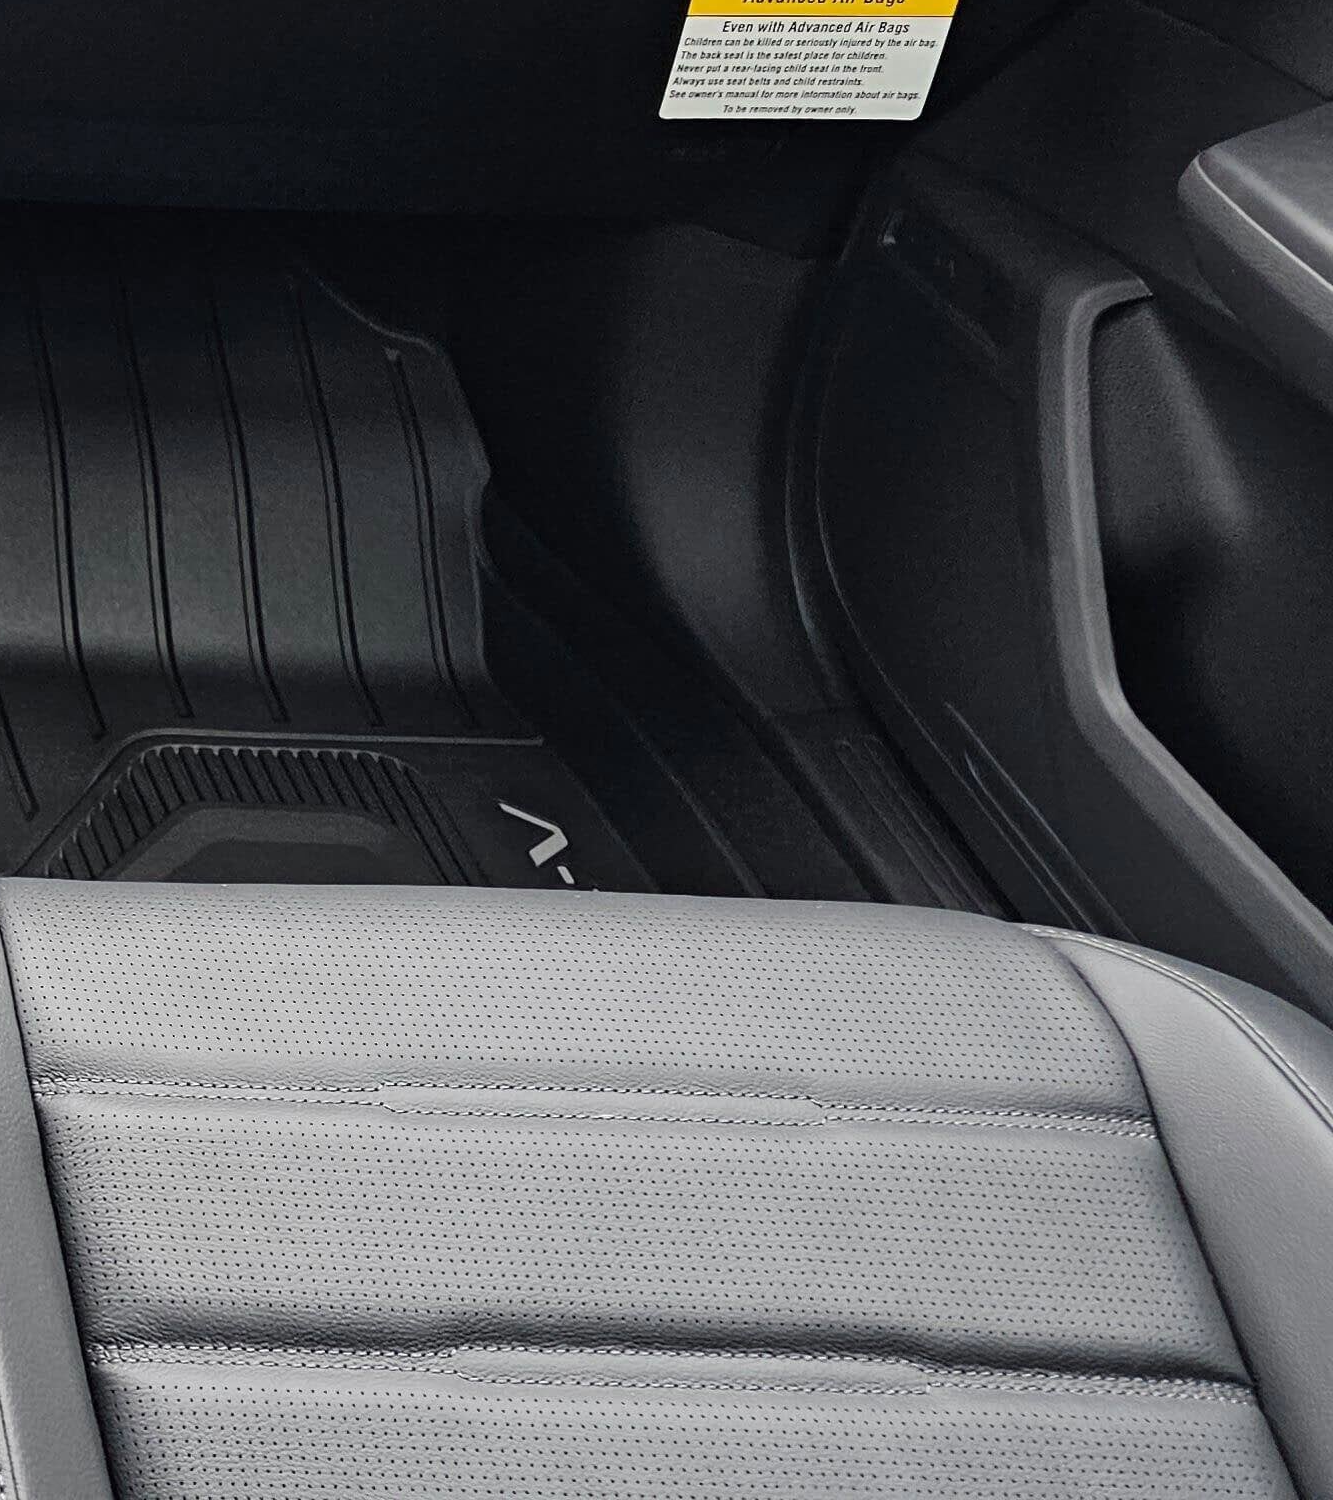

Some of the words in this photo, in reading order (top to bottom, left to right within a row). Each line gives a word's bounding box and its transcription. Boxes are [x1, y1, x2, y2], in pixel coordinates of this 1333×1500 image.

[722, 21, 753, 32] Even
[758, 21, 784, 32] with
[788, 21, 853, 32] Advanced
[855, 21, 875, 32] Air
[878, 22, 910, 35] Bags
[684, 38, 722, 47] Children
[725, 39, 740, 47] can
[743, 38, 754, 47] be
[757, 38, 783, 47] killed
[784, 39, 795, 47] or
[796, 38, 837, 48] seriously
[839, 39, 873, 48] injured
[874, 39, 885, 48] by
[887, 39, 901, 47] the
[903, 39, 917, 47] air
[918, 39, 938, 48] bag.
[681, 51, 697, 59] The
[700, 51, 721, 59] back
[746, 51, 754, 59] is
[757, 51, 771, 59] the
[774, 52, 801, 60] safest
[804, 52, 829, 60] place
[832, 51, 845, 59] for
[847, 52, 887, 60] children.
[706, 65, 721, 73] put
[732, 65, 781, 74] rear-facing
[809, 65, 829, 73] seat
[832, 65, 840, 73] in
[842, 65, 857, 73] the
[860, 65, 884, 73] front.
[673, 77, 705, 87] Always
[817, 78, 863, 86] restraints.
[669, 90, 686, 98] See
[688, 90, 723, 98] owner's
[725, 90, 759, 98] manual
[855, 91, 880, 99] about
[882, 91, 895, 99] air
[896, 91, 921, 101] bags.
[723, 105, 733, 113] To
[736, 105, 747, 113] be
[749, 105, 790, 113] removed
[792, 106, 802, 114] by
[835, 106, 857, 115] only.
